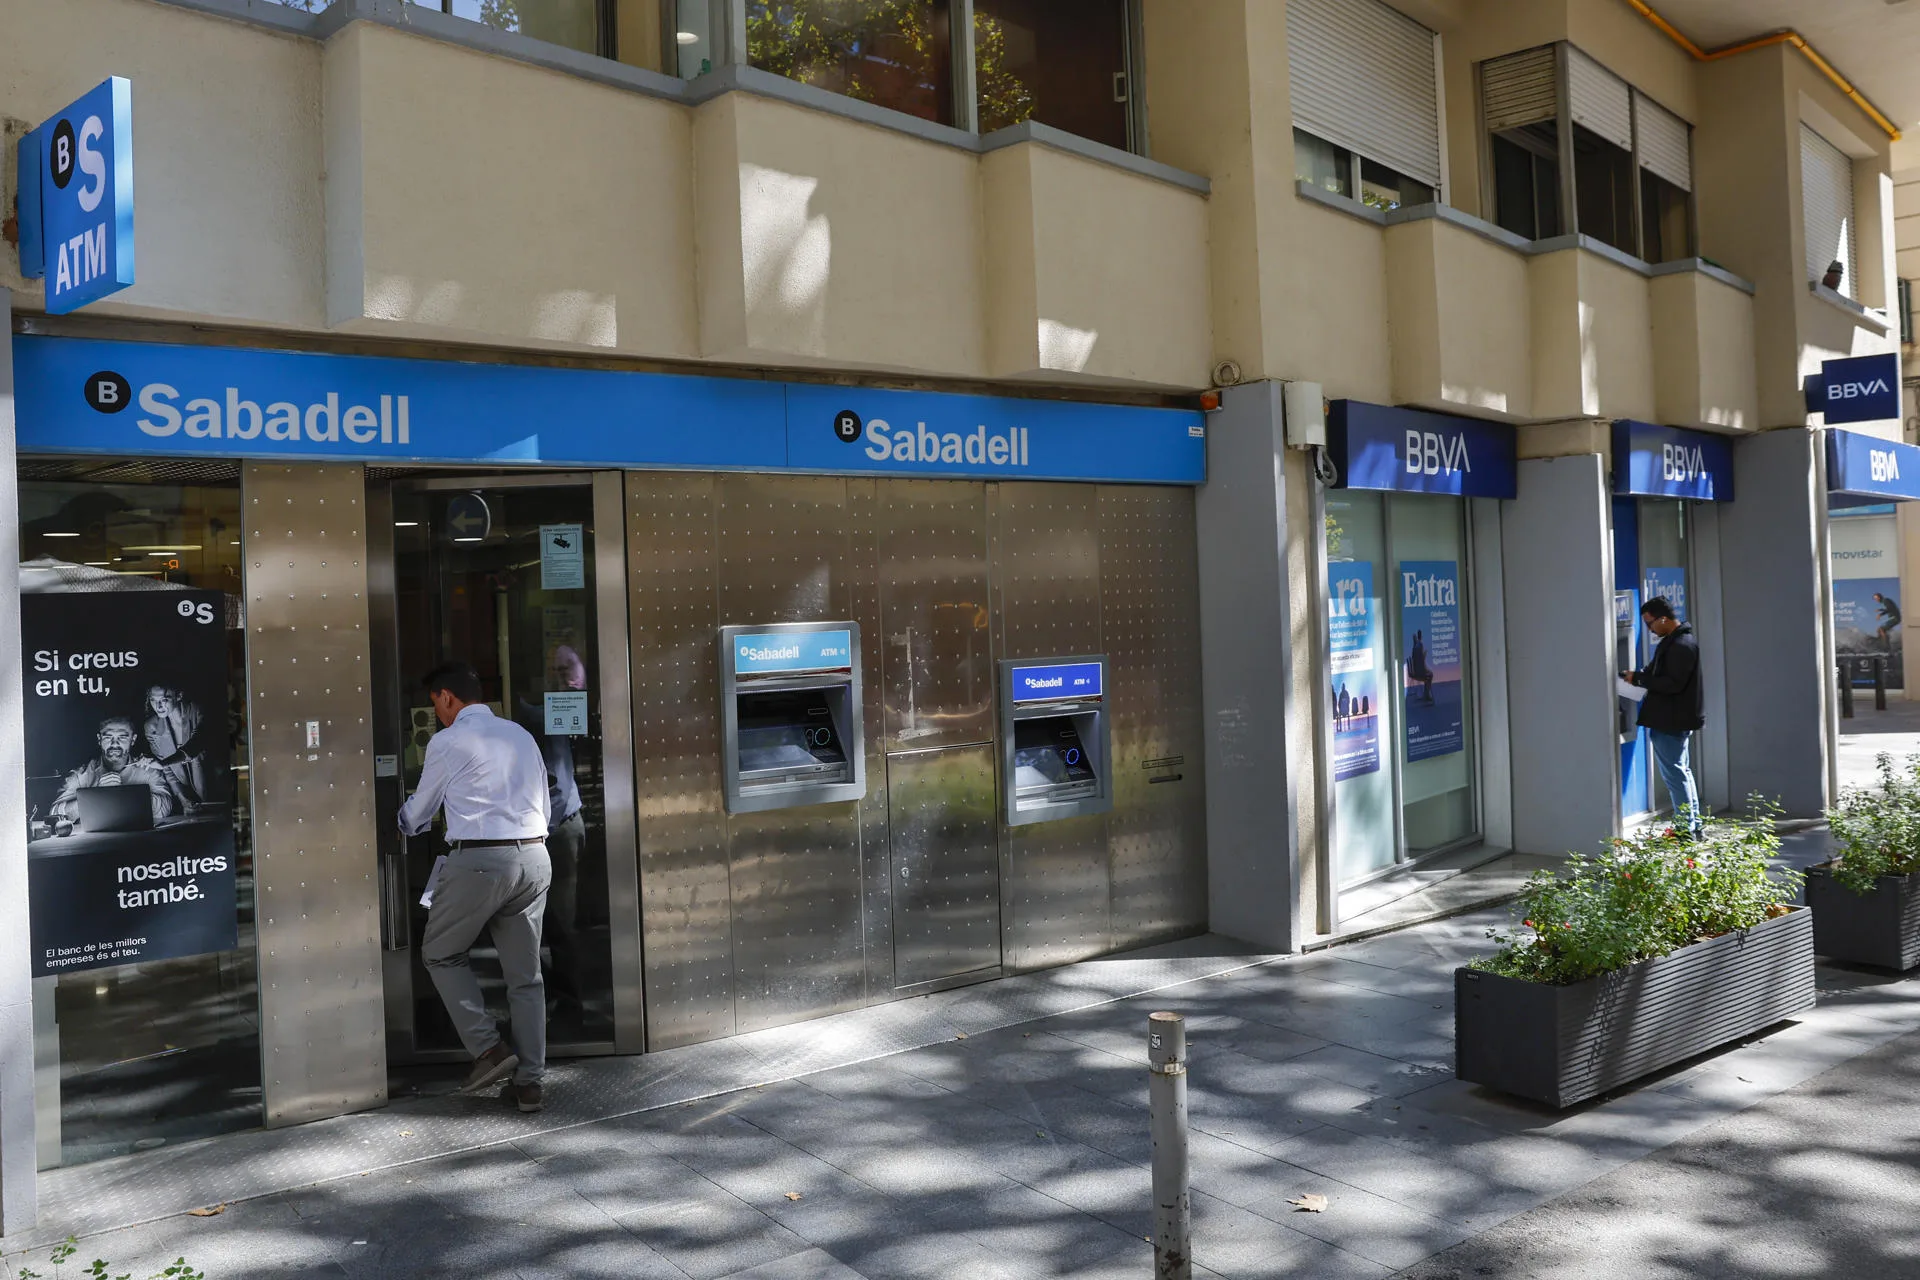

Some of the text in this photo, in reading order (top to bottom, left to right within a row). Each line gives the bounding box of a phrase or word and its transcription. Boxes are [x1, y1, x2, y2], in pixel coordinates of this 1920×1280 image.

[77, 115, 106, 213] S
[55, 222, 107, 296] ATM
[1827, 378, 1889, 400] BBVA
[136, 383, 410, 445] Sabadell
[864, 418, 1028, 467] Sabadell
[1406, 429, 1471, 477] BBVA
[1663, 443, 1707, 483] BBVA
[1870, 449, 1900, 483] BBVA
[1831, 549, 1884, 560] movistar
[1402, 572, 1456, 608] Entra
[195, 602, 214, 625] S
[34, 650, 139, 672] Si creus
[749, 645, 800, 661] Sabadell
[820, 648, 838, 657] ATM
[35, 674, 111, 697] en tu,
[1031, 677, 1063, 689] Sabadell
[1074, 678, 1085, 686] ATM
[117, 855, 228, 883] nosaltres
[117, 878, 205, 909] també.
[46, 937, 147, 958] El banc de les millors
[46, 948, 140, 968] empreses és el teu.
